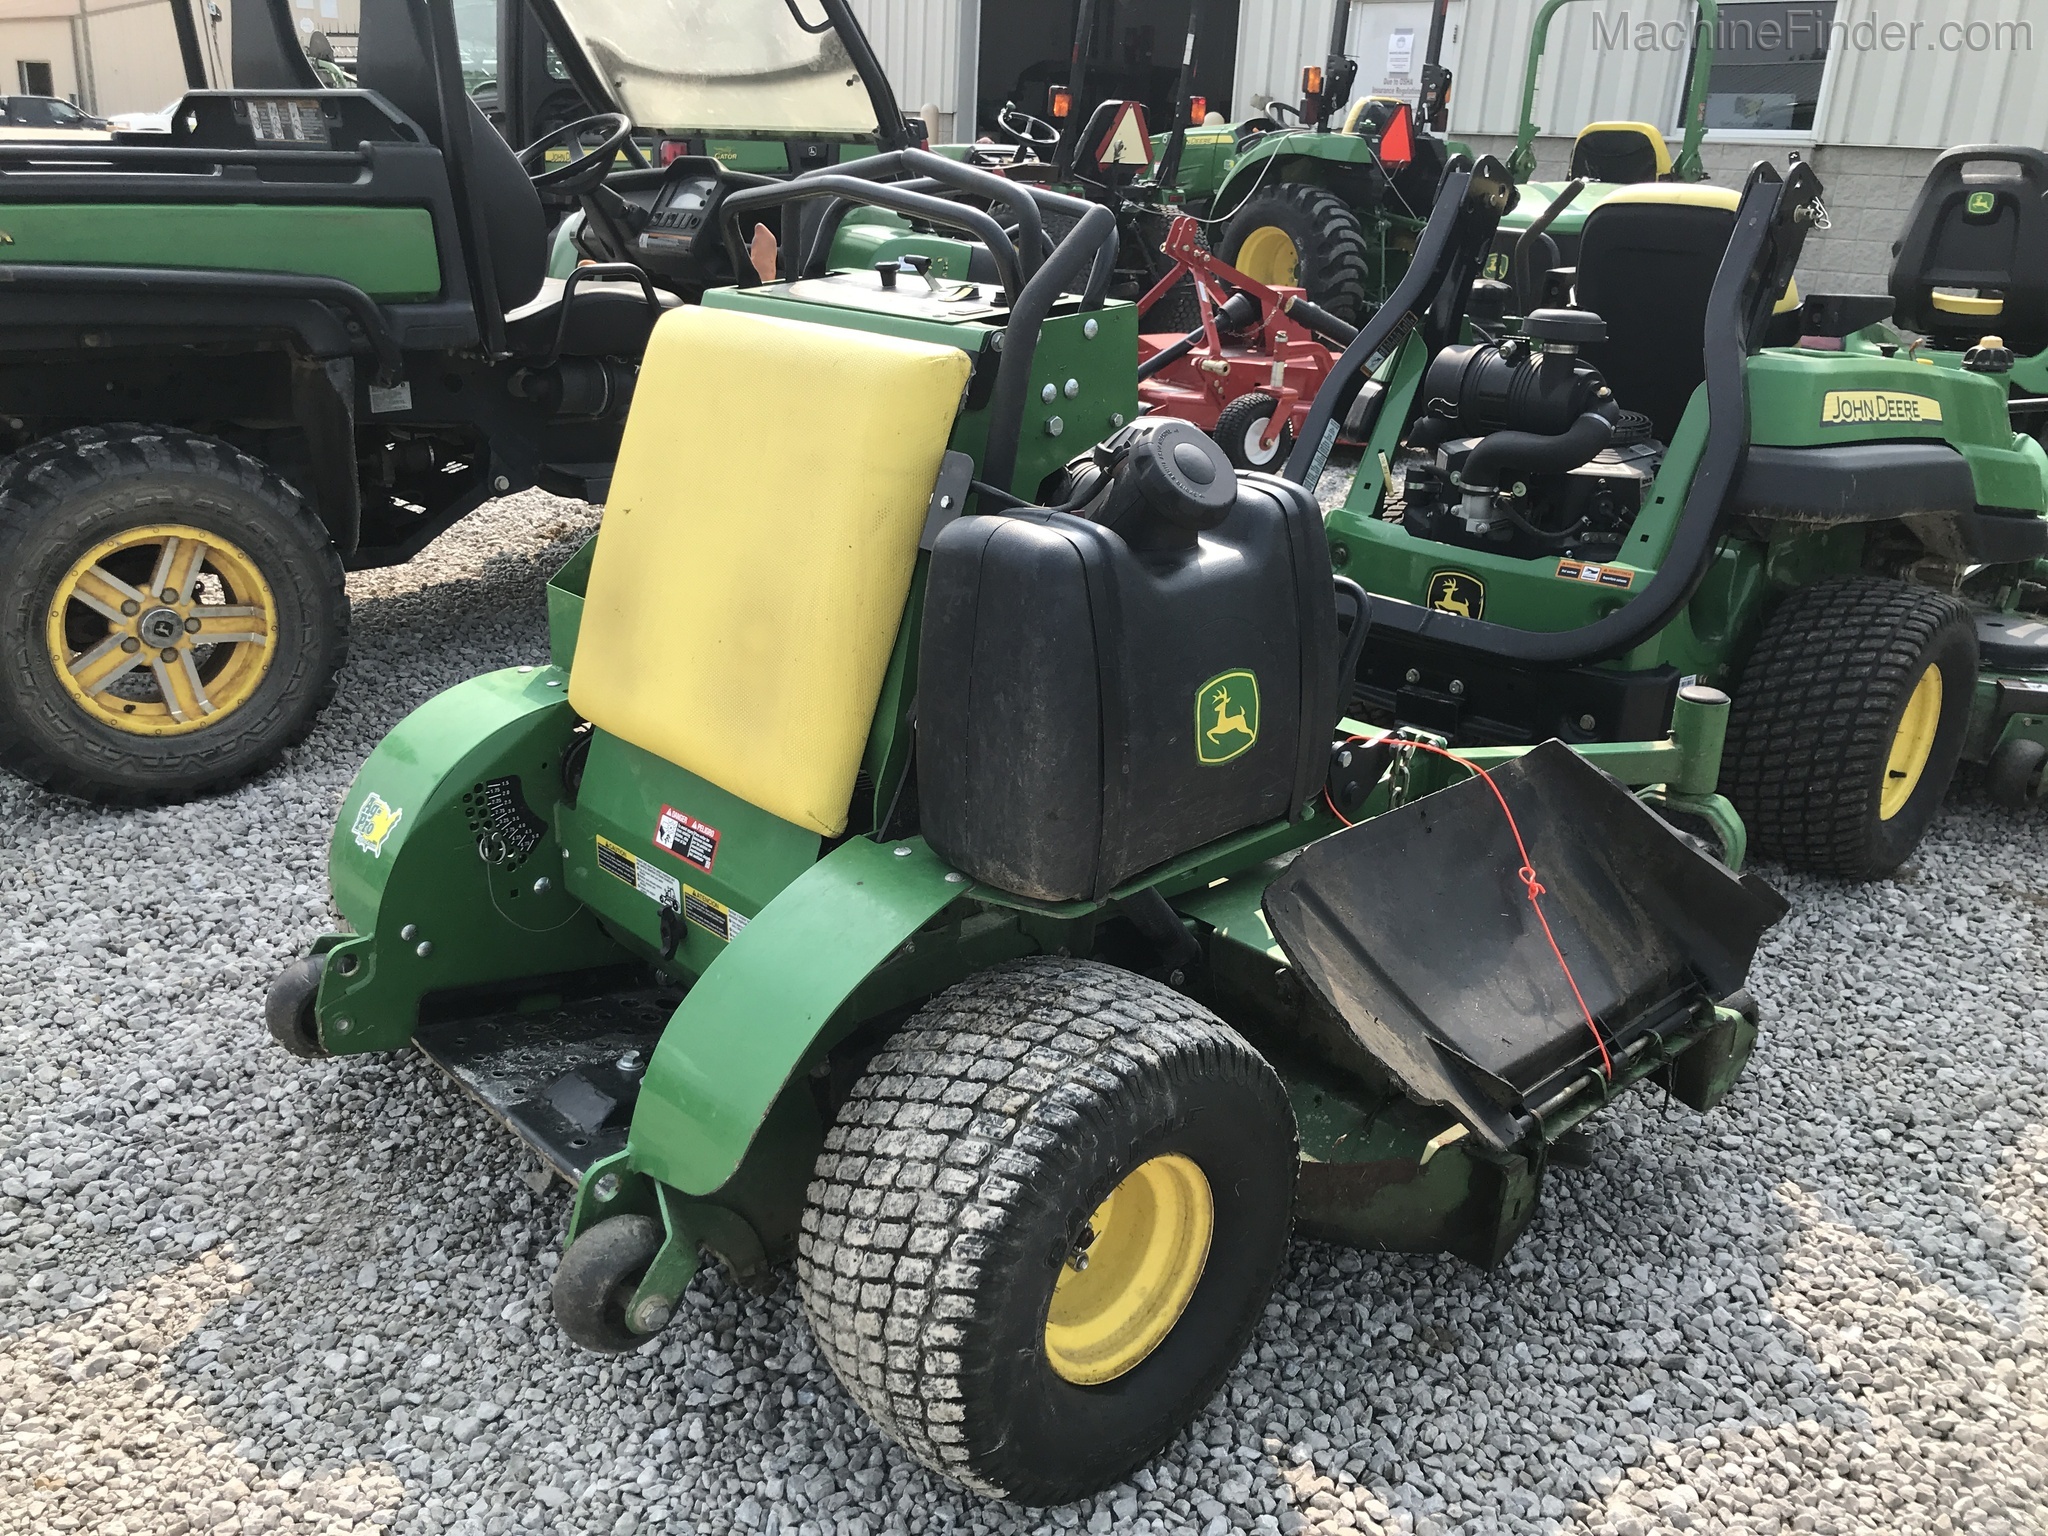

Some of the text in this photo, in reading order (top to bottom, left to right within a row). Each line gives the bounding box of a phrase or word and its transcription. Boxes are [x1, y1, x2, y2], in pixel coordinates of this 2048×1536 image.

[714, 152, 737, 160] GATOR
[1832, 395, 1920, 420] JOHN DEERE
[354, 813, 375, 835] Pro
[671, 810, 689, 825] DANGER
[696, 823, 715, 838] PELIGRO
[608, 842, 628, 858] CAUTION
